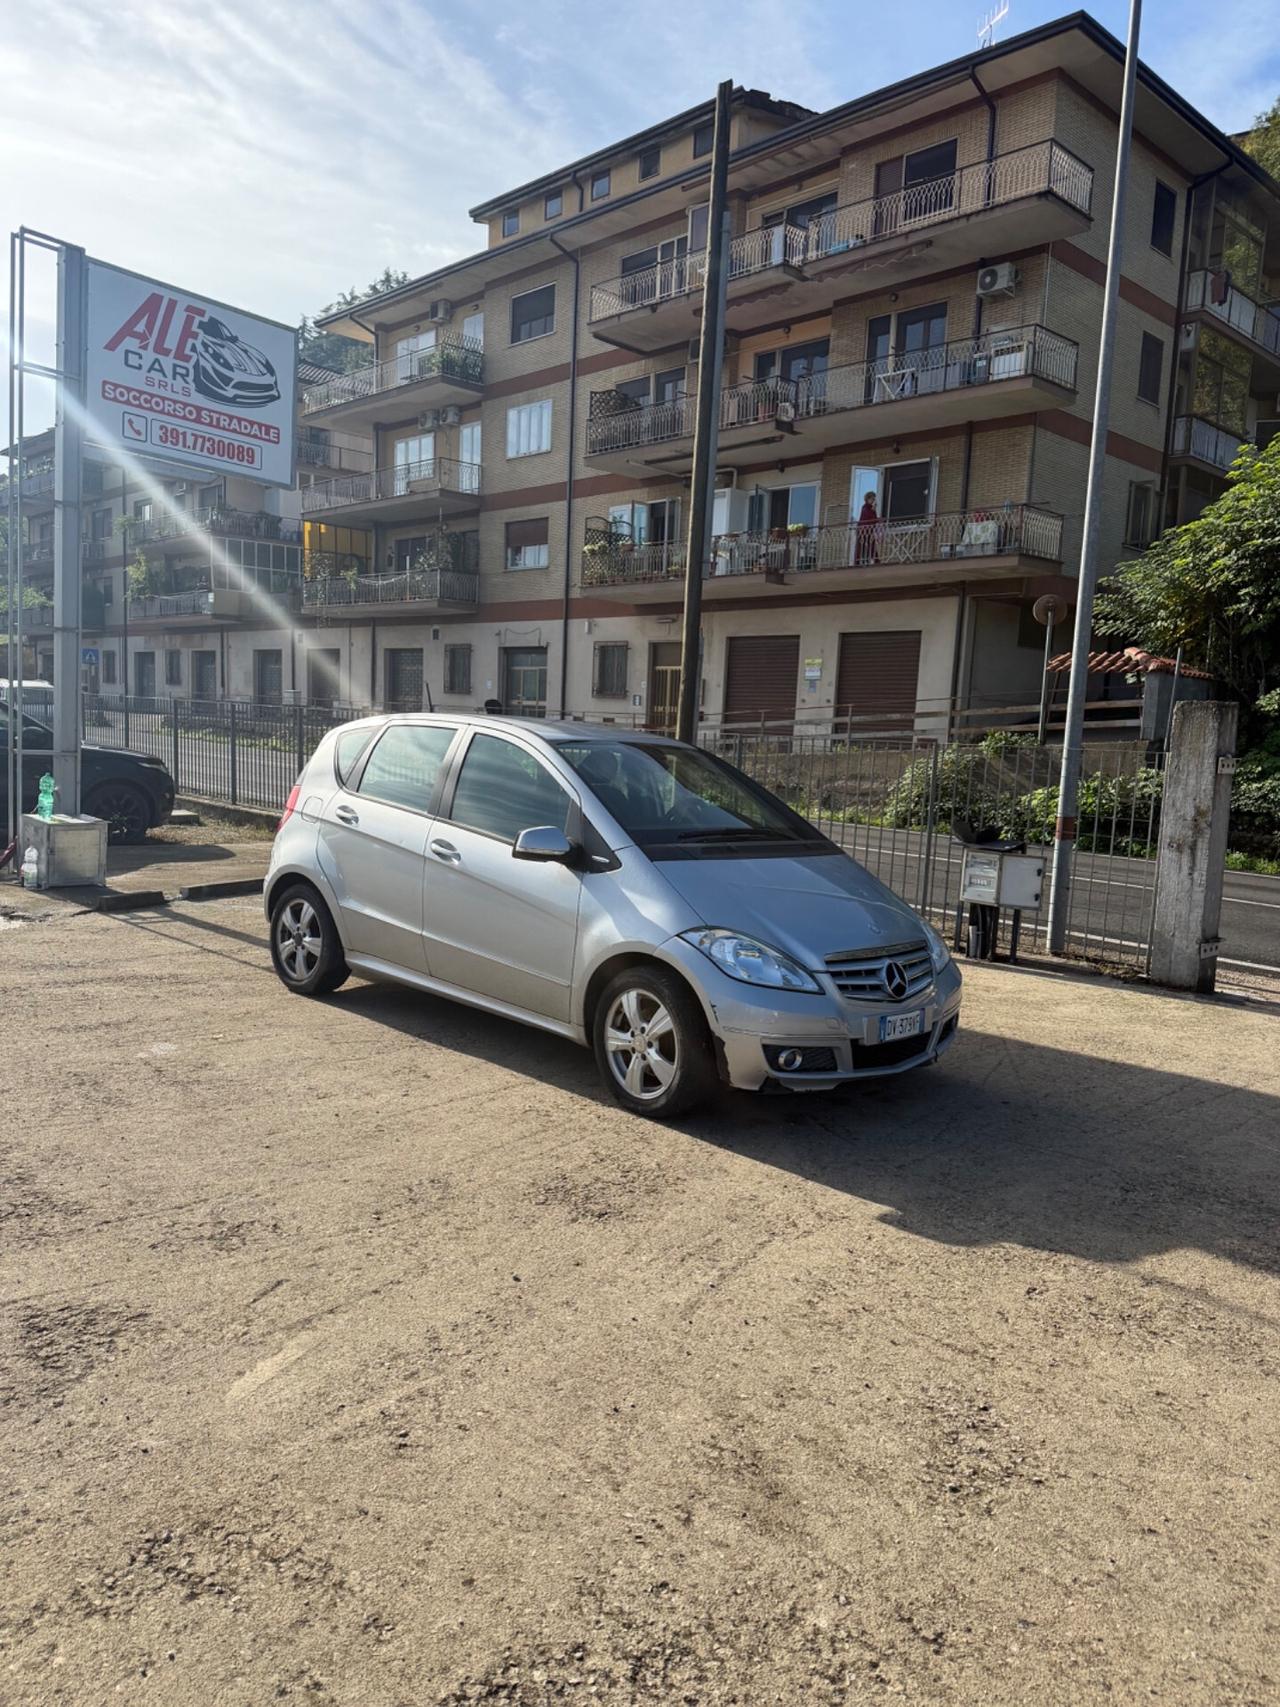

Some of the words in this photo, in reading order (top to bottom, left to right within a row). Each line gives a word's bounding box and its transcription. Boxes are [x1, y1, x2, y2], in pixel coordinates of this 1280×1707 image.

[103, 292, 206, 363] ALE
[124, 348, 190, 384] CAR
[144, 376, 192, 397] SRLS
[104, 384, 197, 420] SOCCORSO
[200, 410, 280, 442] STRADALE
[159, 423, 255, 465] 391.7730089
